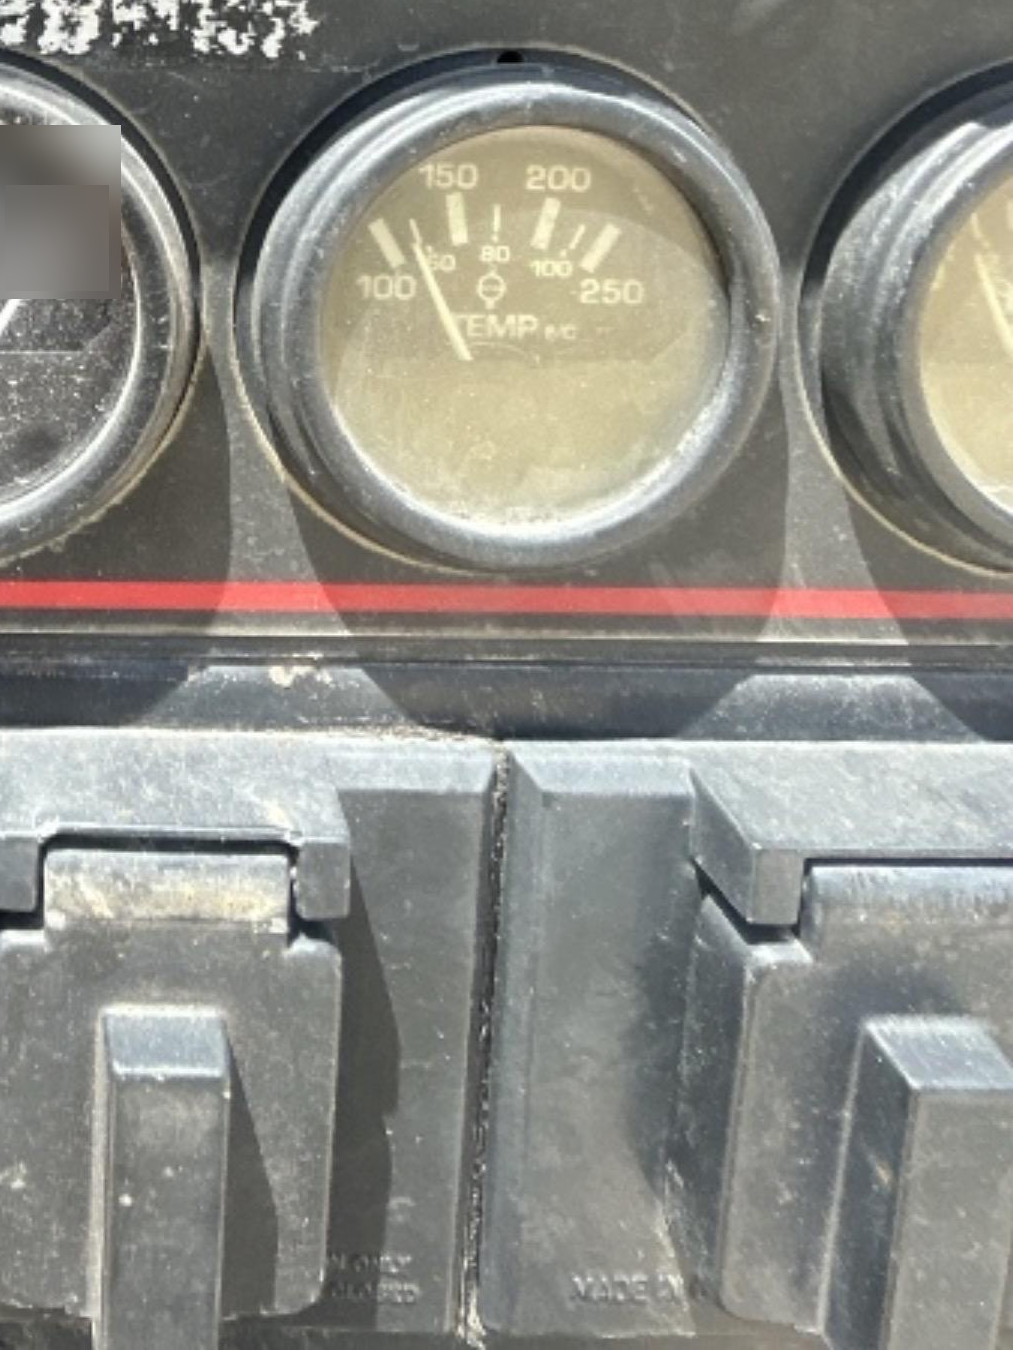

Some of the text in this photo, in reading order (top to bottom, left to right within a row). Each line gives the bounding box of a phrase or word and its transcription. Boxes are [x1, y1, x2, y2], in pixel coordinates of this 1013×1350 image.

[419, 163, 479, 191] 150
[526, 165, 591, 192] 200
[479, 244, 511, 263] 80
[530, 260, 573, 278] 100
[356, 275, 416, 301] 100
[579, 278, 644, 305] 250
